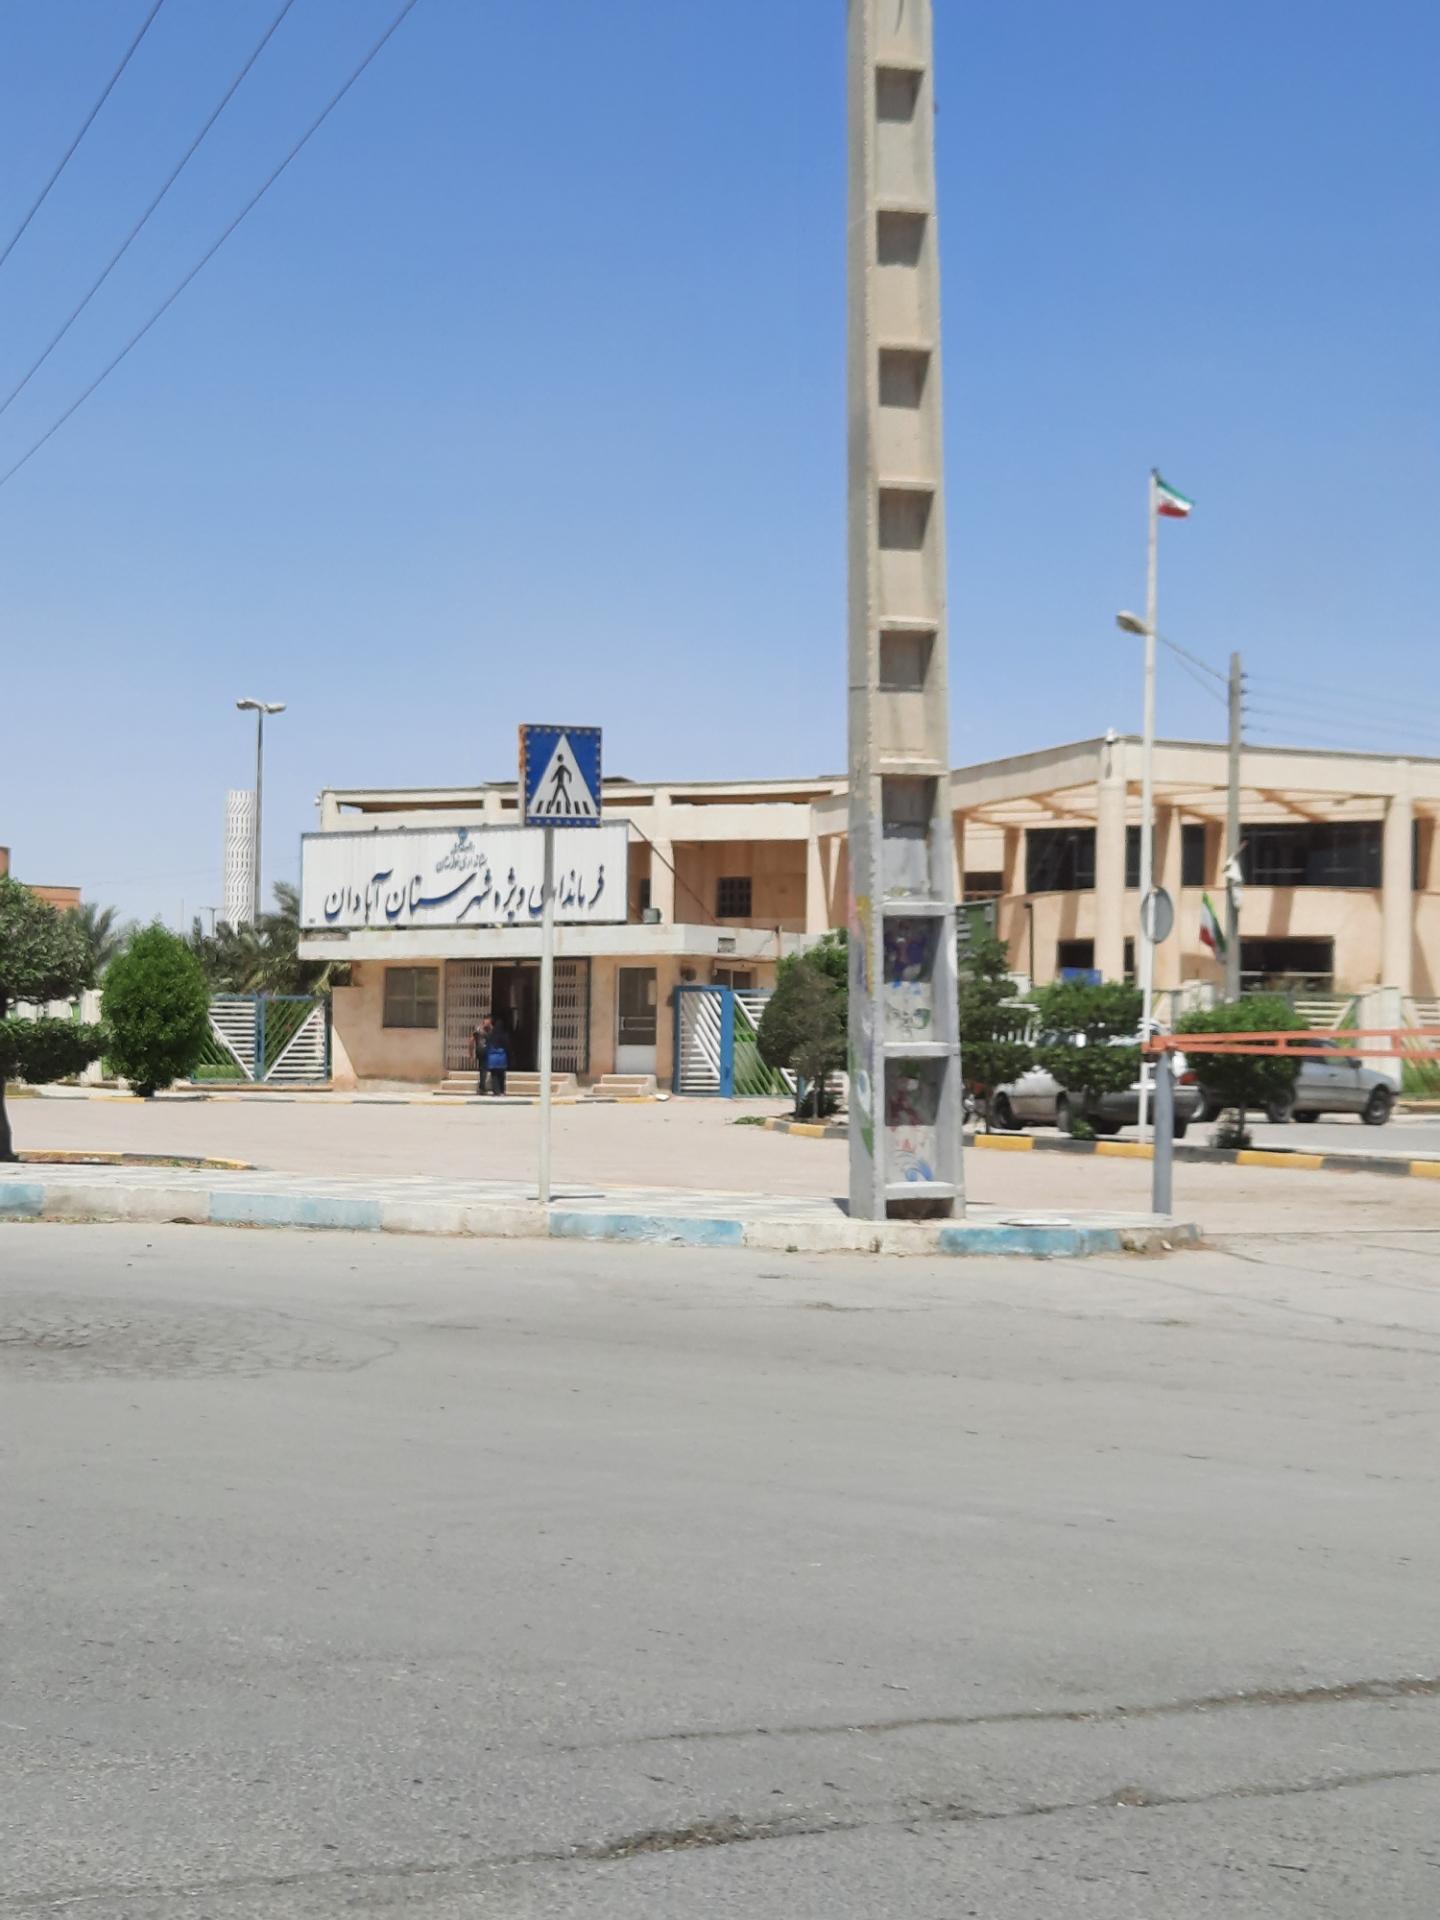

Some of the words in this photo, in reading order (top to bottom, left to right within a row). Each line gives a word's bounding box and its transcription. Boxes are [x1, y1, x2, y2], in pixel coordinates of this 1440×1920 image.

[324, 868, 394, 923] آبادان
[385, 868, 493, 921] شهرستان
[494, 866, 526, 920] ویژه
